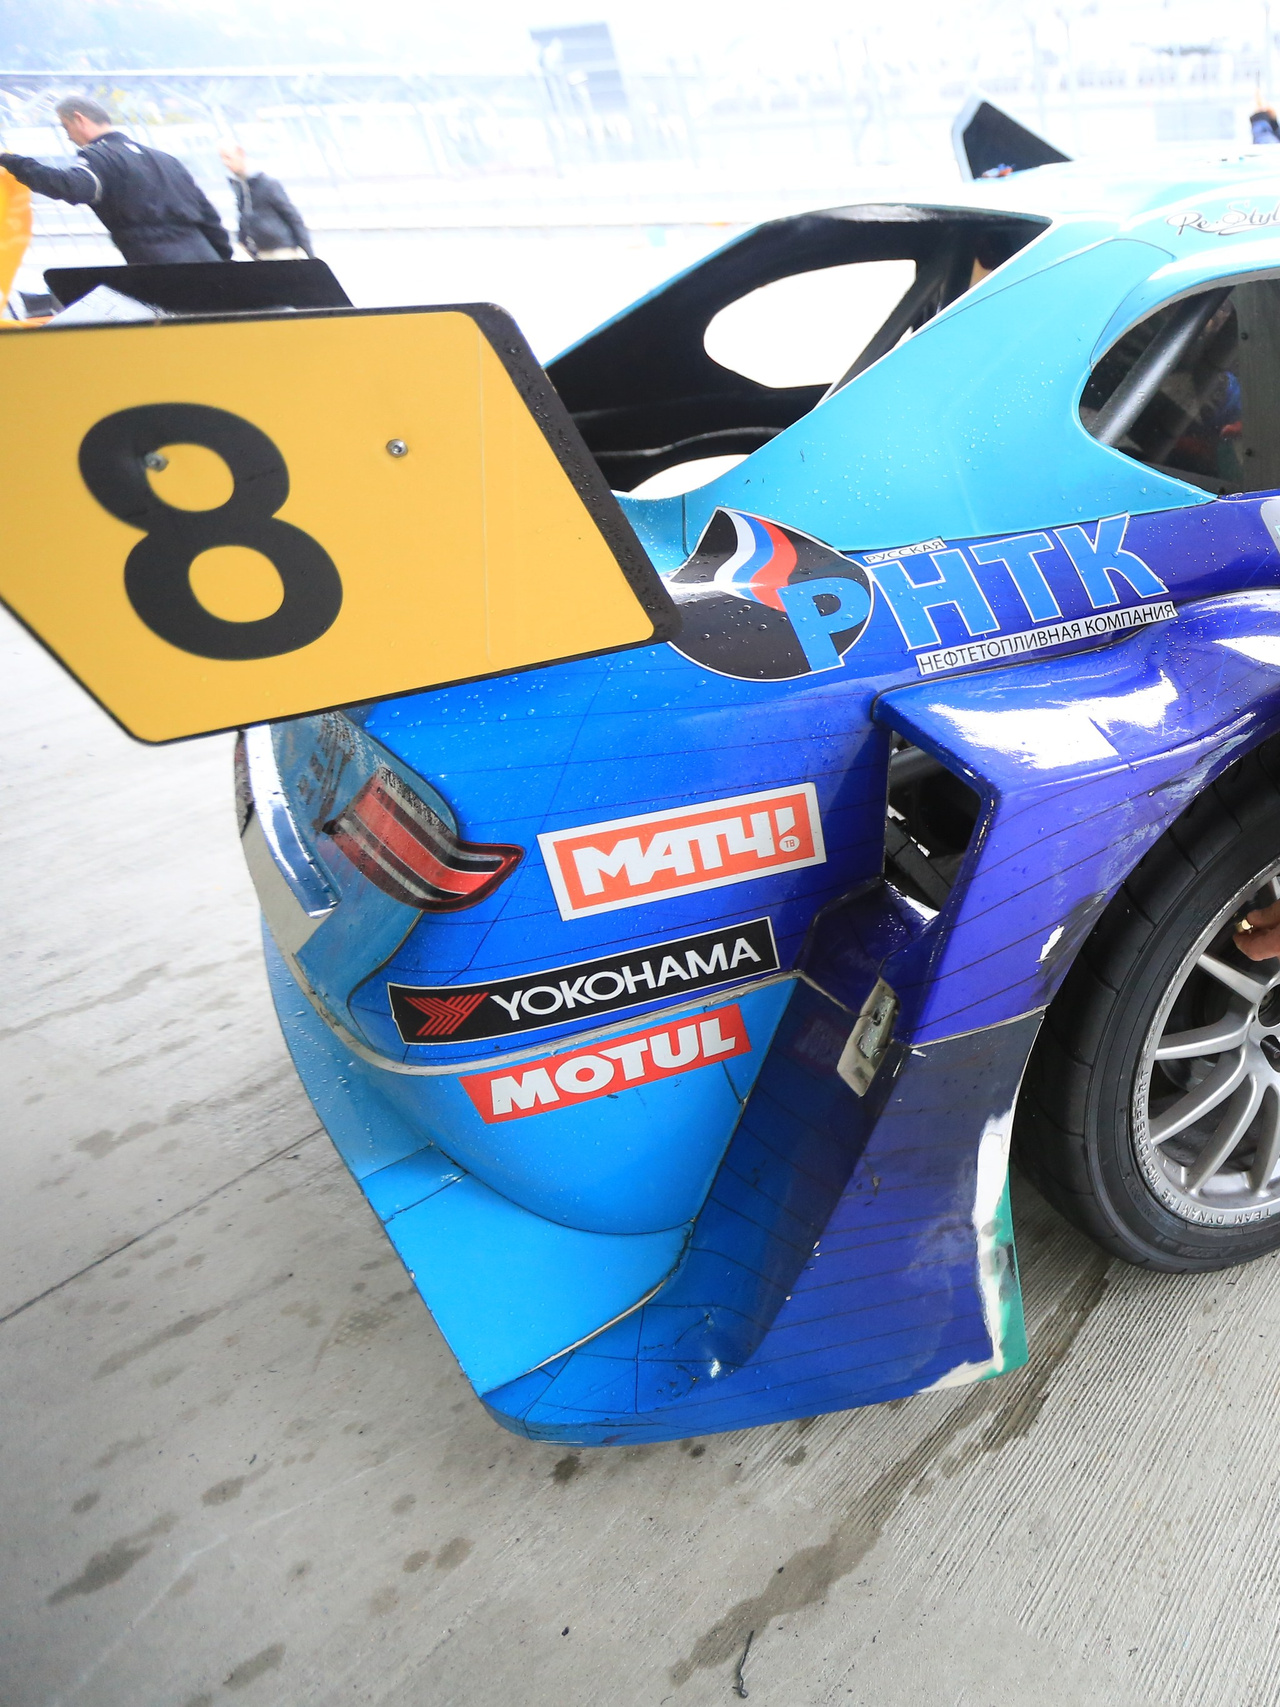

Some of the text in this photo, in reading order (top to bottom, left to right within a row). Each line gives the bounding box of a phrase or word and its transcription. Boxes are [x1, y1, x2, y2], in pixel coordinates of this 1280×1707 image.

[78, 401, 343, 661] 8
[865, 538, 944, 563] РУССКАЯ
[919, 604, 1176, 674] НЕФТЕТОПЛИВНАЯ КОМПАНИЯ
[490, 937, 761, 1021] YOKOHAMA
[490, 1017, 736, 1115] MOTUL
[1234, 1208, 1272, 1225] TEAM
